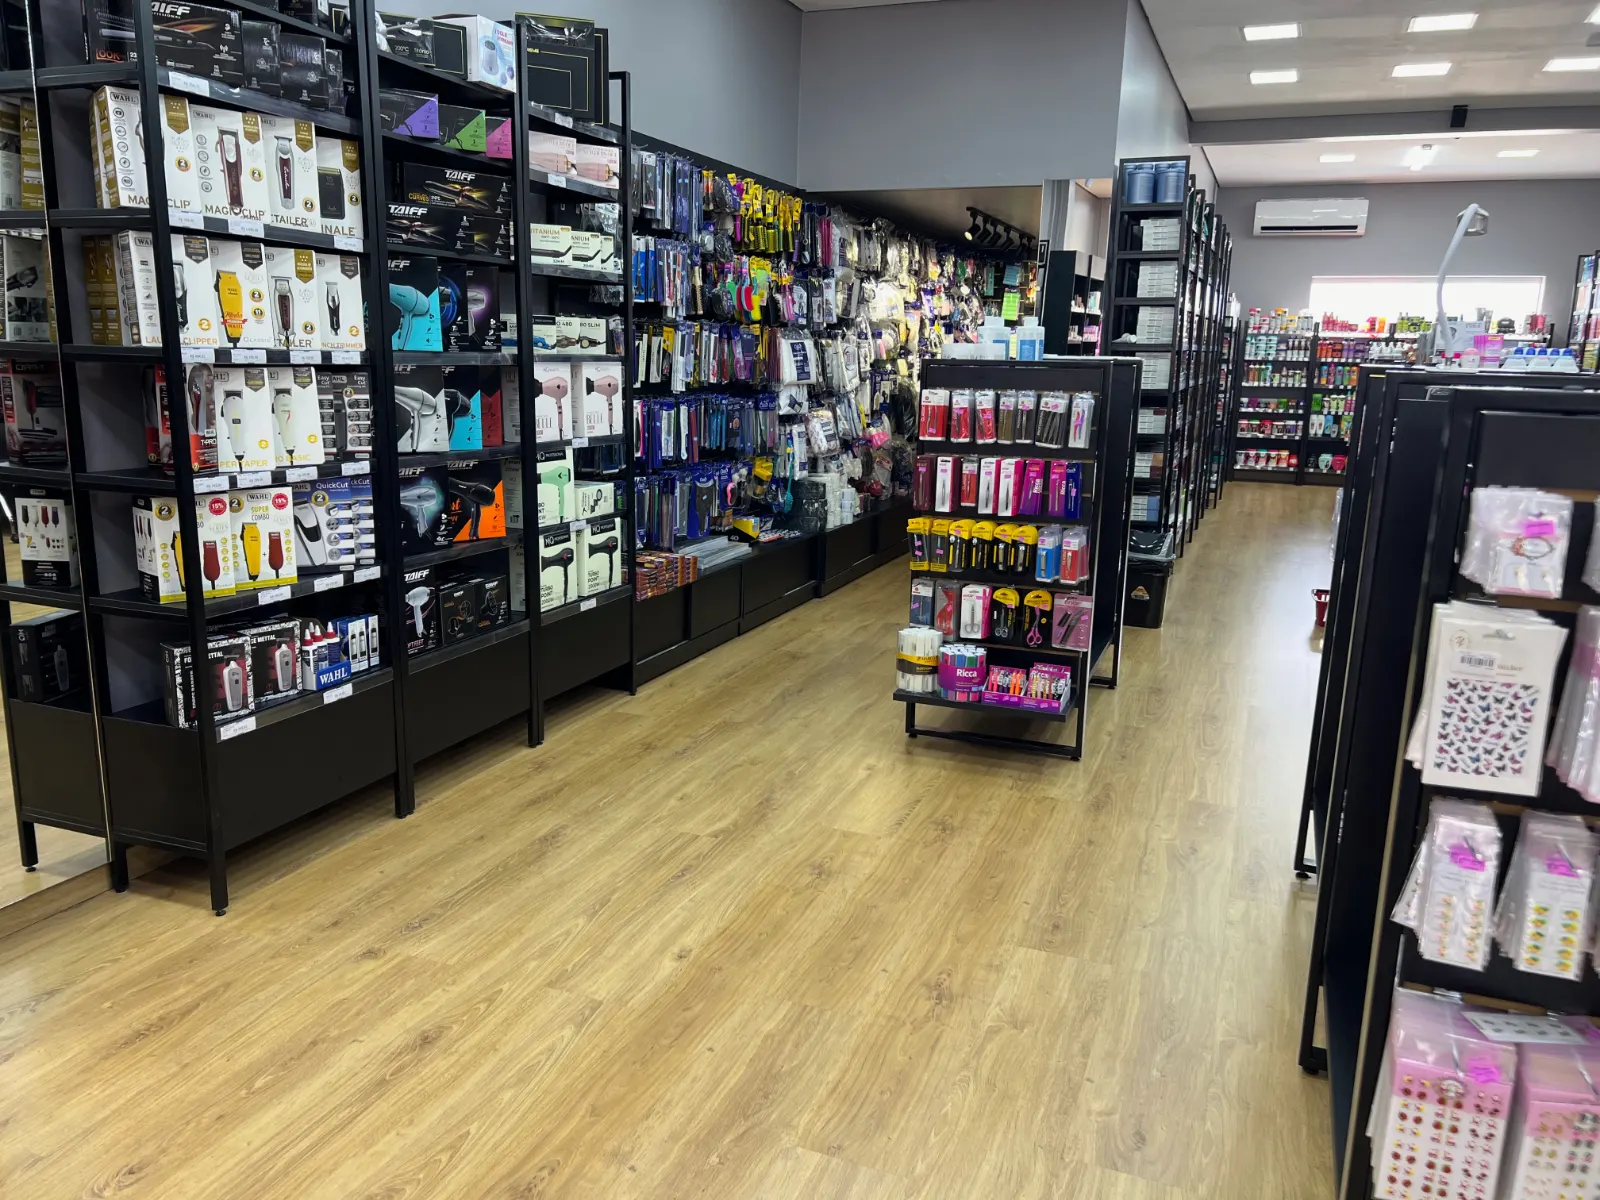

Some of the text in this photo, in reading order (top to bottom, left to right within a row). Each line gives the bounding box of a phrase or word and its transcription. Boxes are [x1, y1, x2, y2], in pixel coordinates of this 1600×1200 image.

[151, 1, 190, 15] AIFF
[444, 169, 476, 181] TAIFF
[388, 204, 428, 216] TAIFF
[321, 224, 356, 237] INALE
[387, 260, 411, 269] IFF
[447, 460, 479, 469] TAIFF
[315, 482, 349, 490] QuickCut
[249, 493, 269, 501] WAHL
[250, 505, 269, 514] SUPER
[403, 569, 430, 582] TAIFF
[207, 652, 224, 660] ETTAL
[319, 667, 348, 686] WAHL
[956, 668, 978, 678] Ricca
